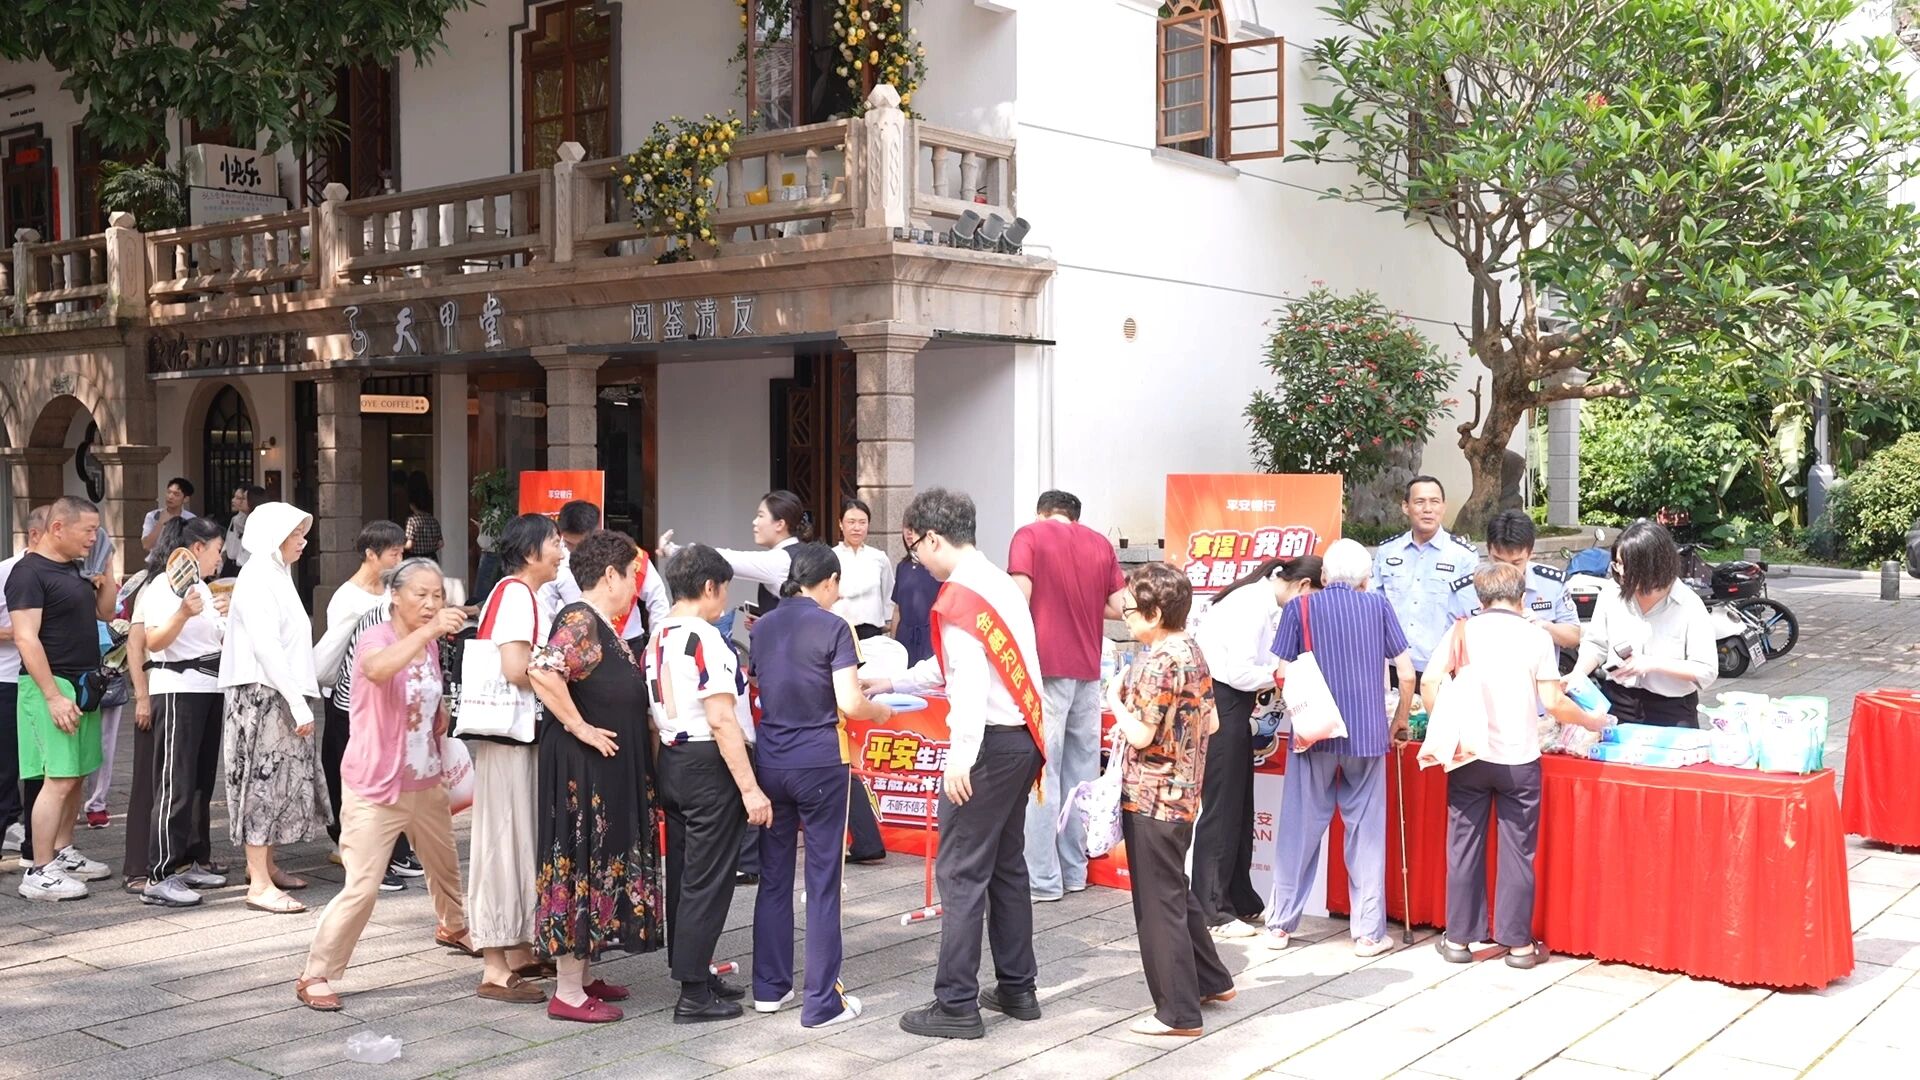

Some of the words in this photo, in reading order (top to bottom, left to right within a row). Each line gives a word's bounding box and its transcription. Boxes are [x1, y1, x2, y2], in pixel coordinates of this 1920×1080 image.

[221, 153, 261, 187] 快乐
[630, 296, 756, 342] 阅鉴清友
[380, 399, 411, 409] COFFEE
[1253, 811, 1272, 826] 安
